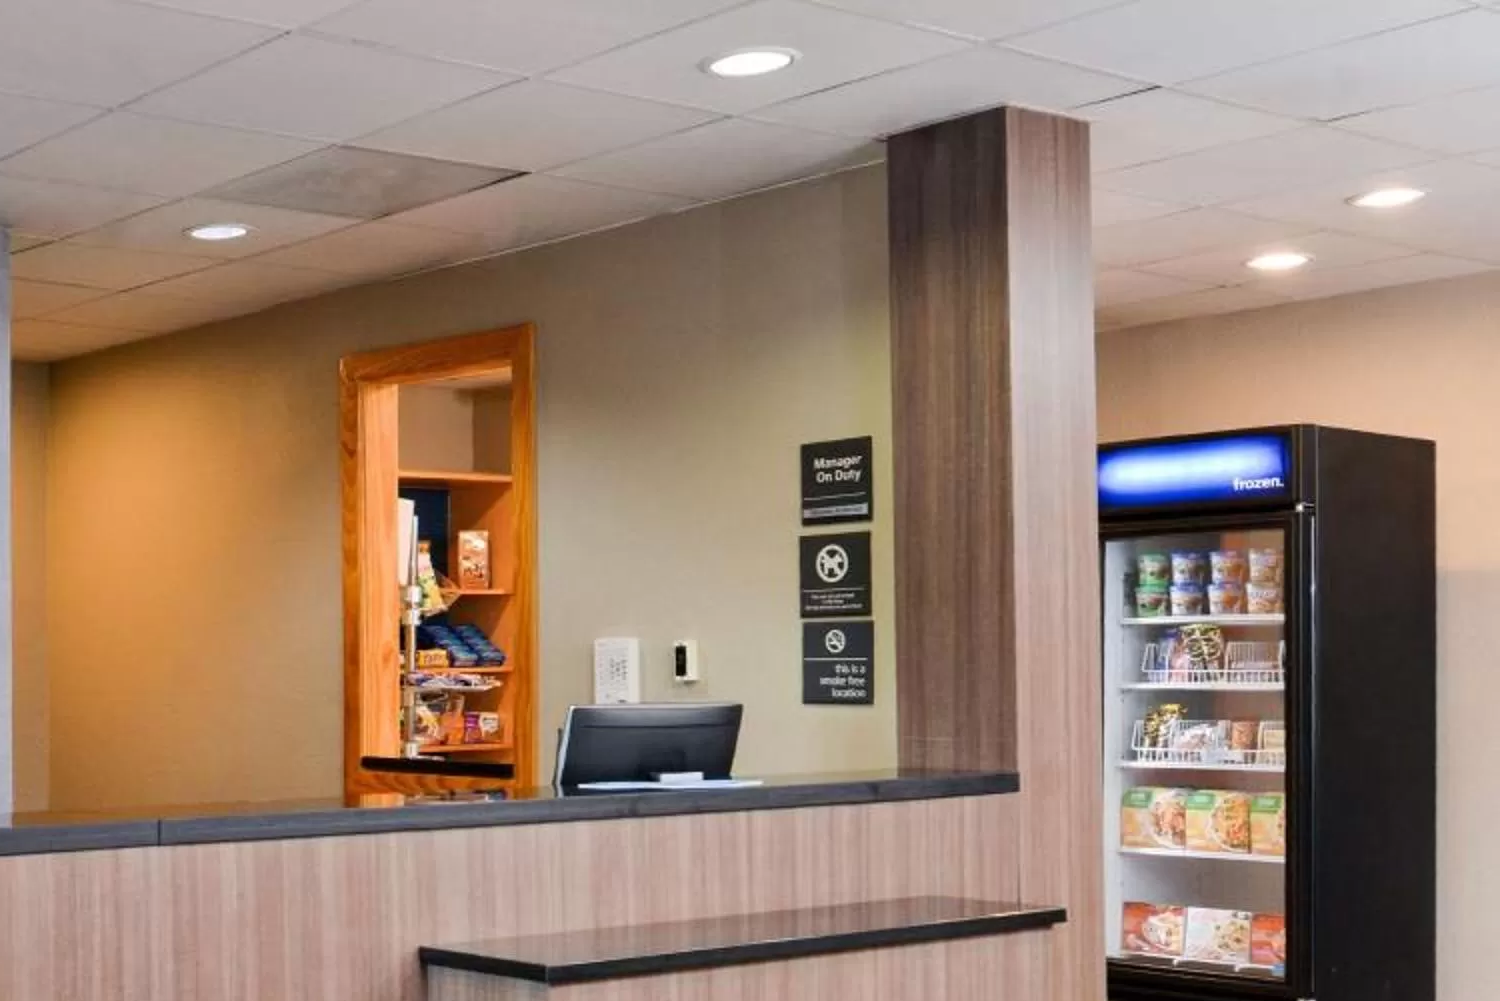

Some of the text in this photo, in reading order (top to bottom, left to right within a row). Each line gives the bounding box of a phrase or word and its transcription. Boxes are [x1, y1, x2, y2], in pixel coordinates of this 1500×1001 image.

[813, 455, 863, 469] Manager
[816, 469, 862, 483] On Duty
[1232, 477, 1285, 492] frozen.
[831, 687, 868, 698] location
